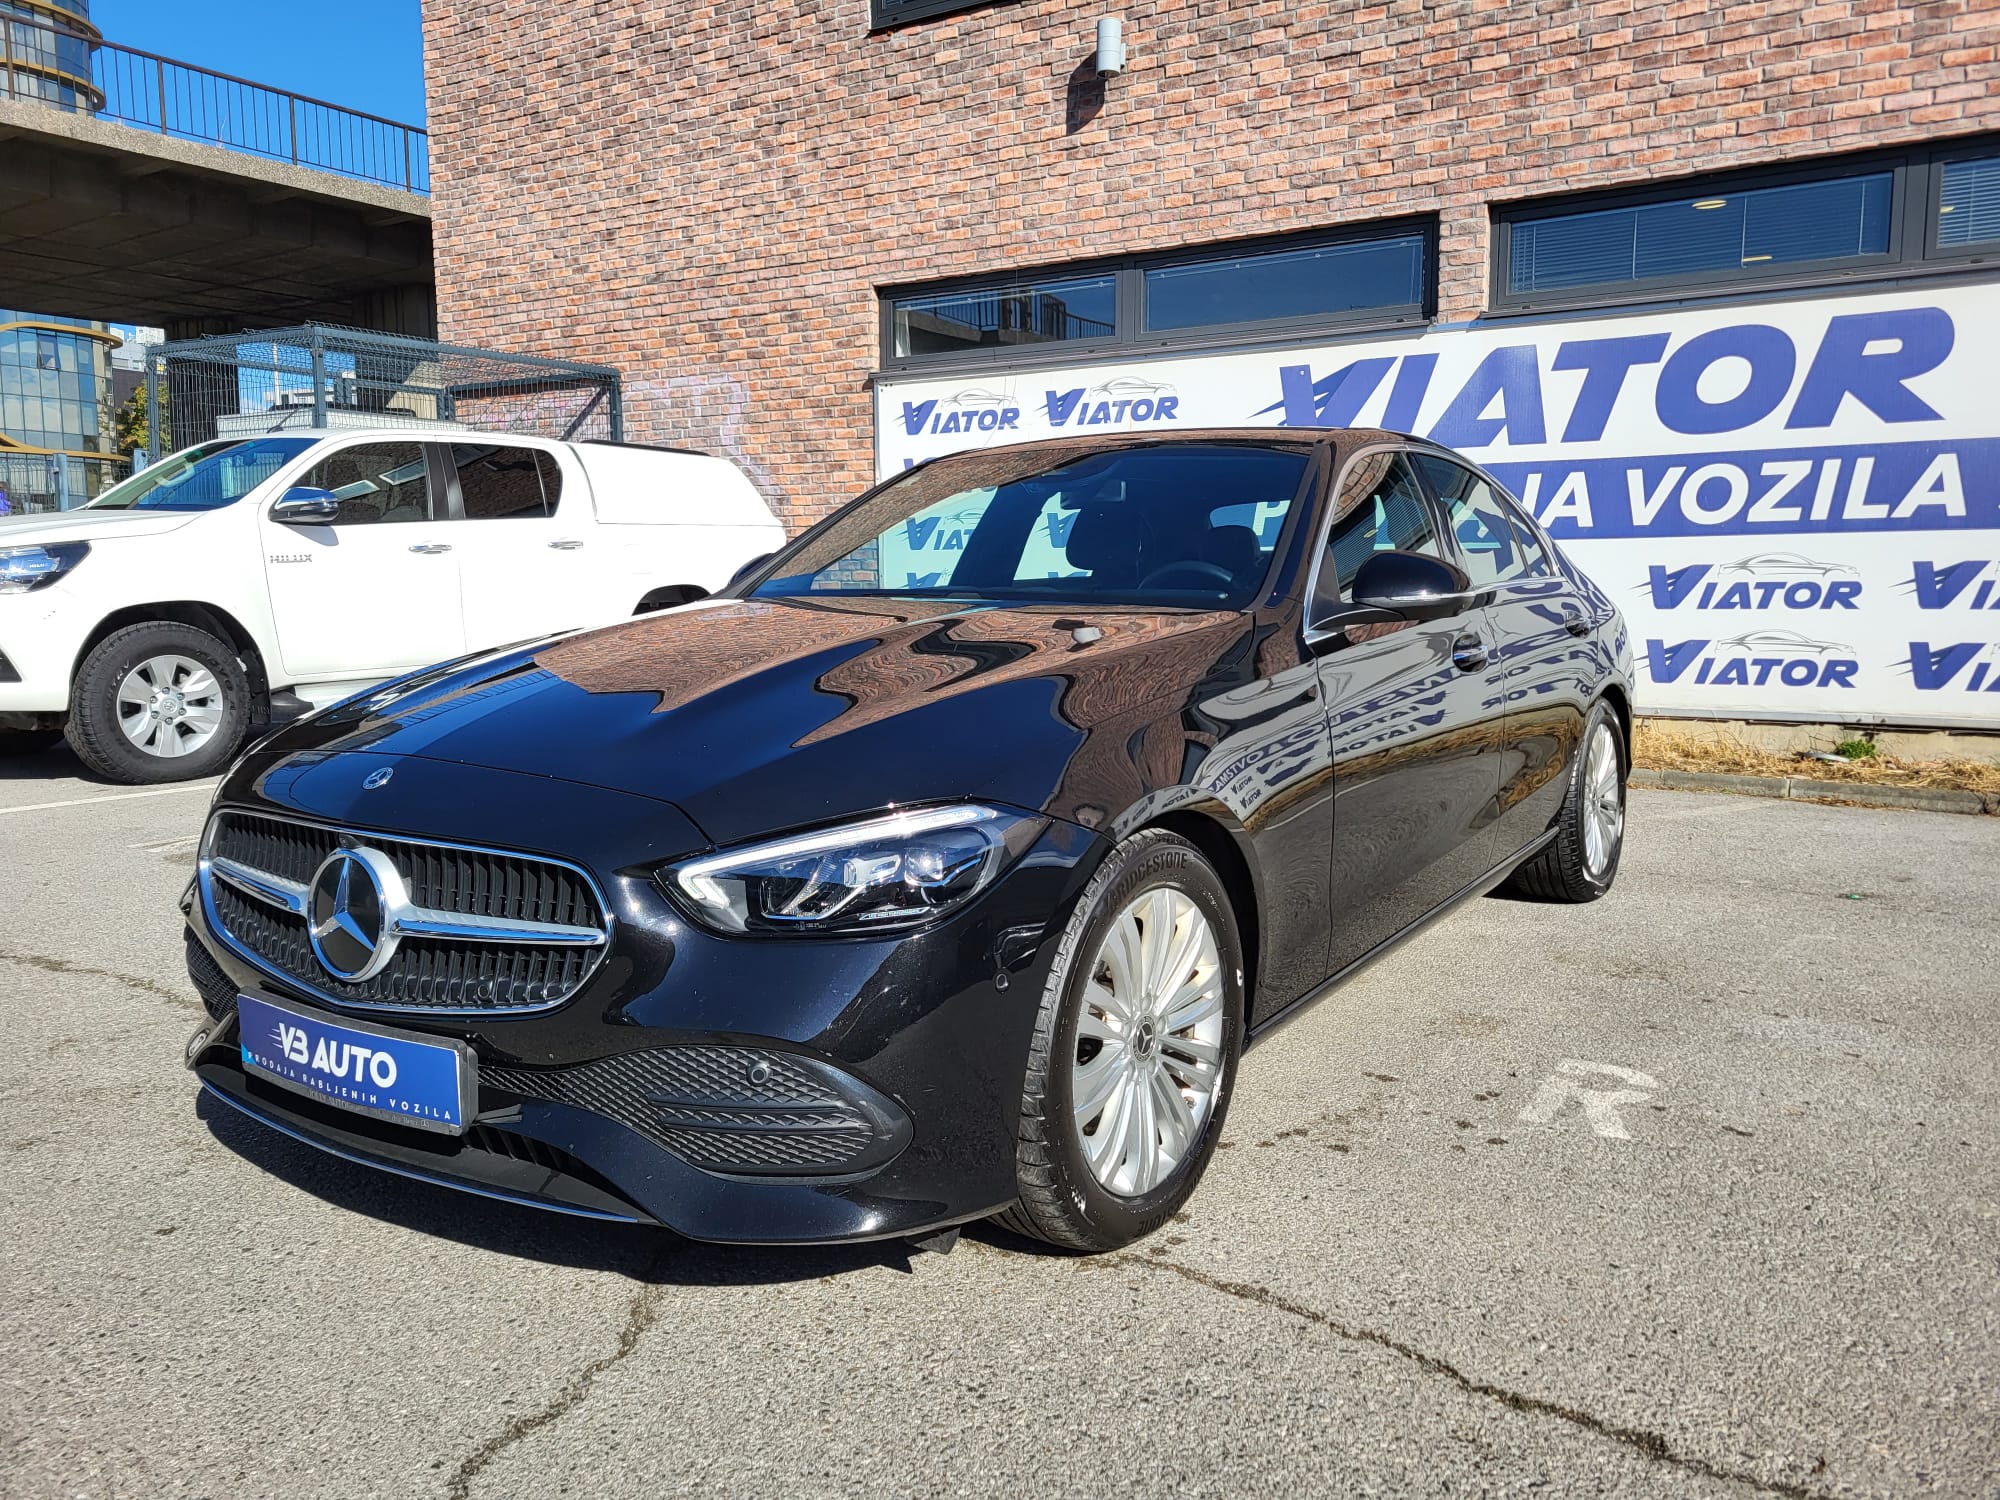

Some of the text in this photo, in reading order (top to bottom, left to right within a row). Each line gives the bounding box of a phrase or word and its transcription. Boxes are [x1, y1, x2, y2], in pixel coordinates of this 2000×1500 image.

[1272, 306, 1956, 449] VIATOR
[899, 399, 1020, 436] VIATOR
[1041, 387, 1179, 427] VIATOR
[1625, 452, 1967, 527] VOZILA
[1642, 563, 1864, 610] VIATOR
[1642, 638, 1860, 688] VIATOR
[247, 1051, 295, 1078] PRODAJA
[303, 1073, 377, 1105] RABLJENIH
[390, 1098, 451, 1121] VOZILA
[312, 1036, 397, 1088] AUTO
